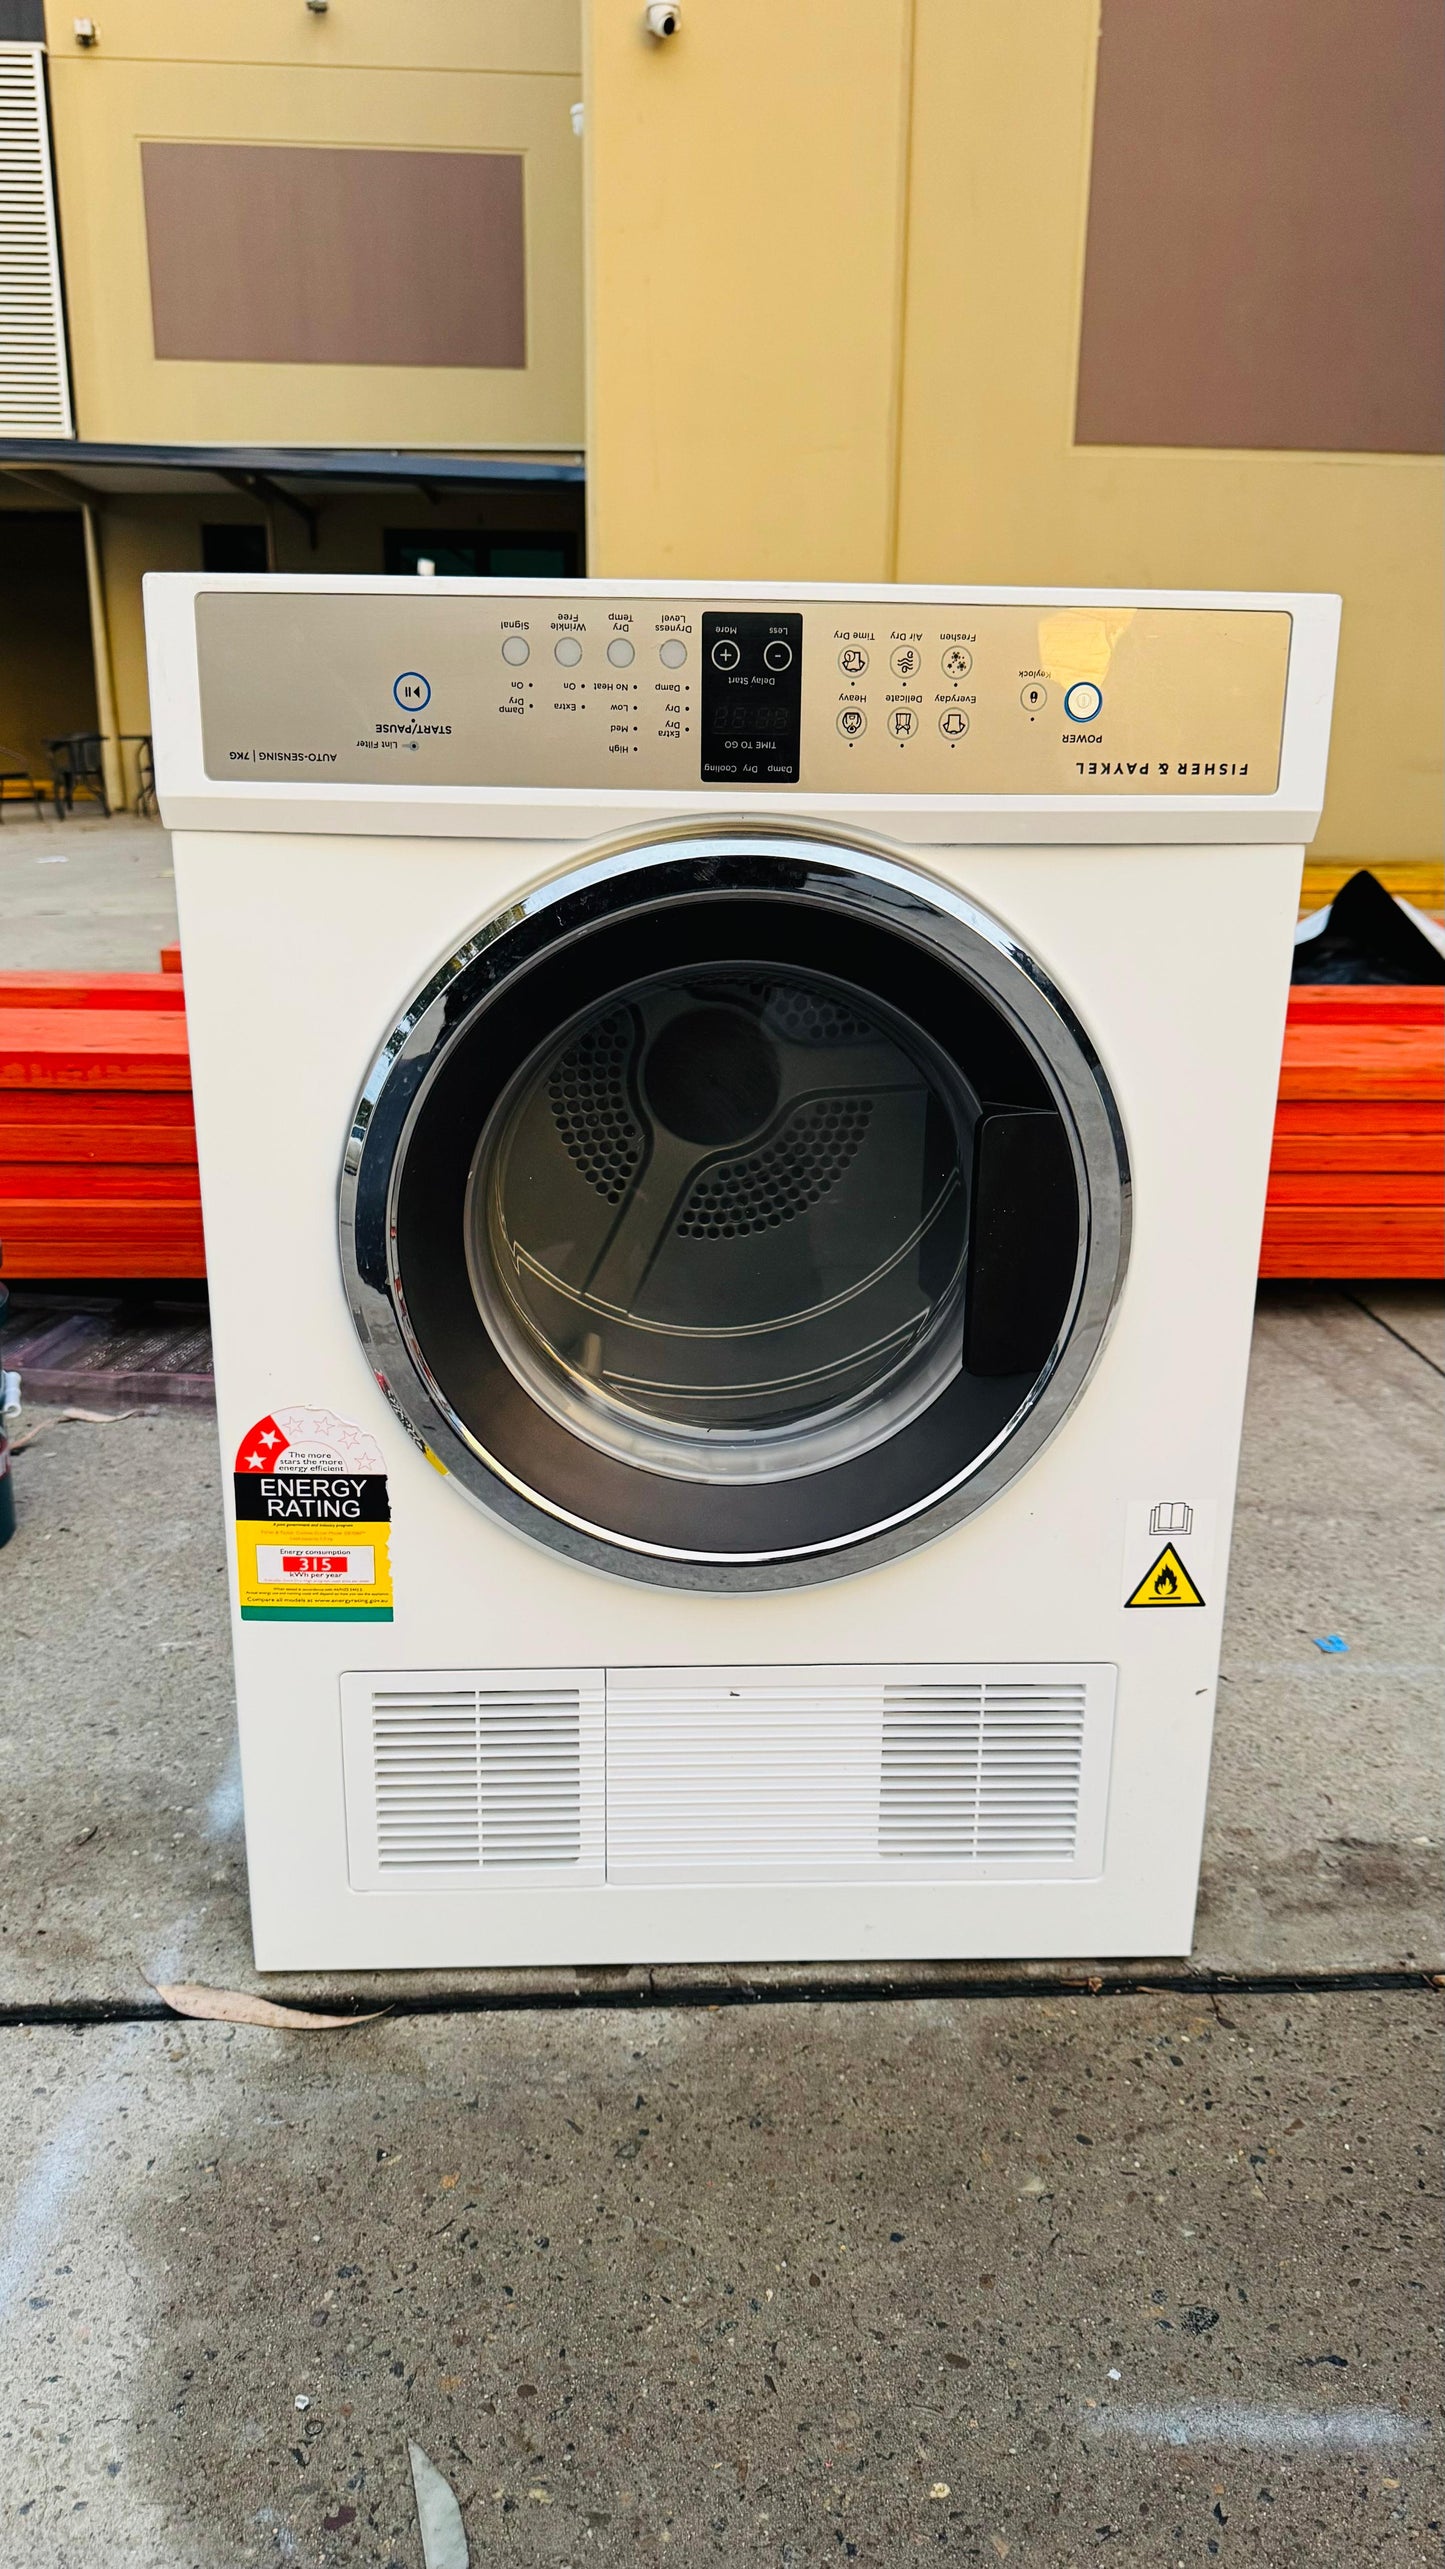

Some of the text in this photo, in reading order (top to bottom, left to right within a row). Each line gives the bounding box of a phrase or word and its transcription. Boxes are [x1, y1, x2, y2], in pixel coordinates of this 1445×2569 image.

[558, 614, 578, 622] Free
[608, 613, 633, 622] Temp
[661, 615, 685, 623] Level
[500, 620, 530, 630] Signal
[551, 622, 586, 631] Wrinkle
[613, 623, 629, 632] Dry
[655, 624, 692, 633] Dryness
[716, 626, 737, 634] More
[769, 627, 788, 635] Less
[833, 631, 875, 641] Time Dry
[890, 632, 923, 641] Air Dry
[939, 633, 976, 642] Freshen
[1018, 669, 1052, 679] Keylock
[511, 681, 524, 689] On
[728, 676, 775, 685] Delay Start
[563, 682, 576, 690] On
[593, 683, 628, 691] No Heat
[655, 683, 680, 692] Damp
[509, 697, 524, 705] Dry
[838, 693, 867, 703] Heavy
[885, 694, 923, 704] Delicate
[934, 694, 976, 704] Everyday
[499, 706, 524, 714] Damp
[554, 703, 576, 711] Extra
[611, 704, 628, 712] Low
[665, 704, 680, 713] Dry
[665, 720, 680, 729] Dry
[375, 724, 452, 735] START/PAUSE
[658, 730, 680, 738] Extra
[1062, 734, 1103, 744] POWER
[356, 740, 398, 749] Lint Filter
[609, 745, 628, 753] High
[724, 741, 777, 749] TIME TO GO
[229, 751, 337, 762] AUTO-SENSING 7KG
[704, 764, 792, 774] Damp Dry Cooling
[1075, 762, 1248, 775] FISHER & PAYKEL
[261, 1479, 367, 1497] ENERGY
[267, 1500, 360, 1518] RATING
[299, 1558, 332, 1571] 315
